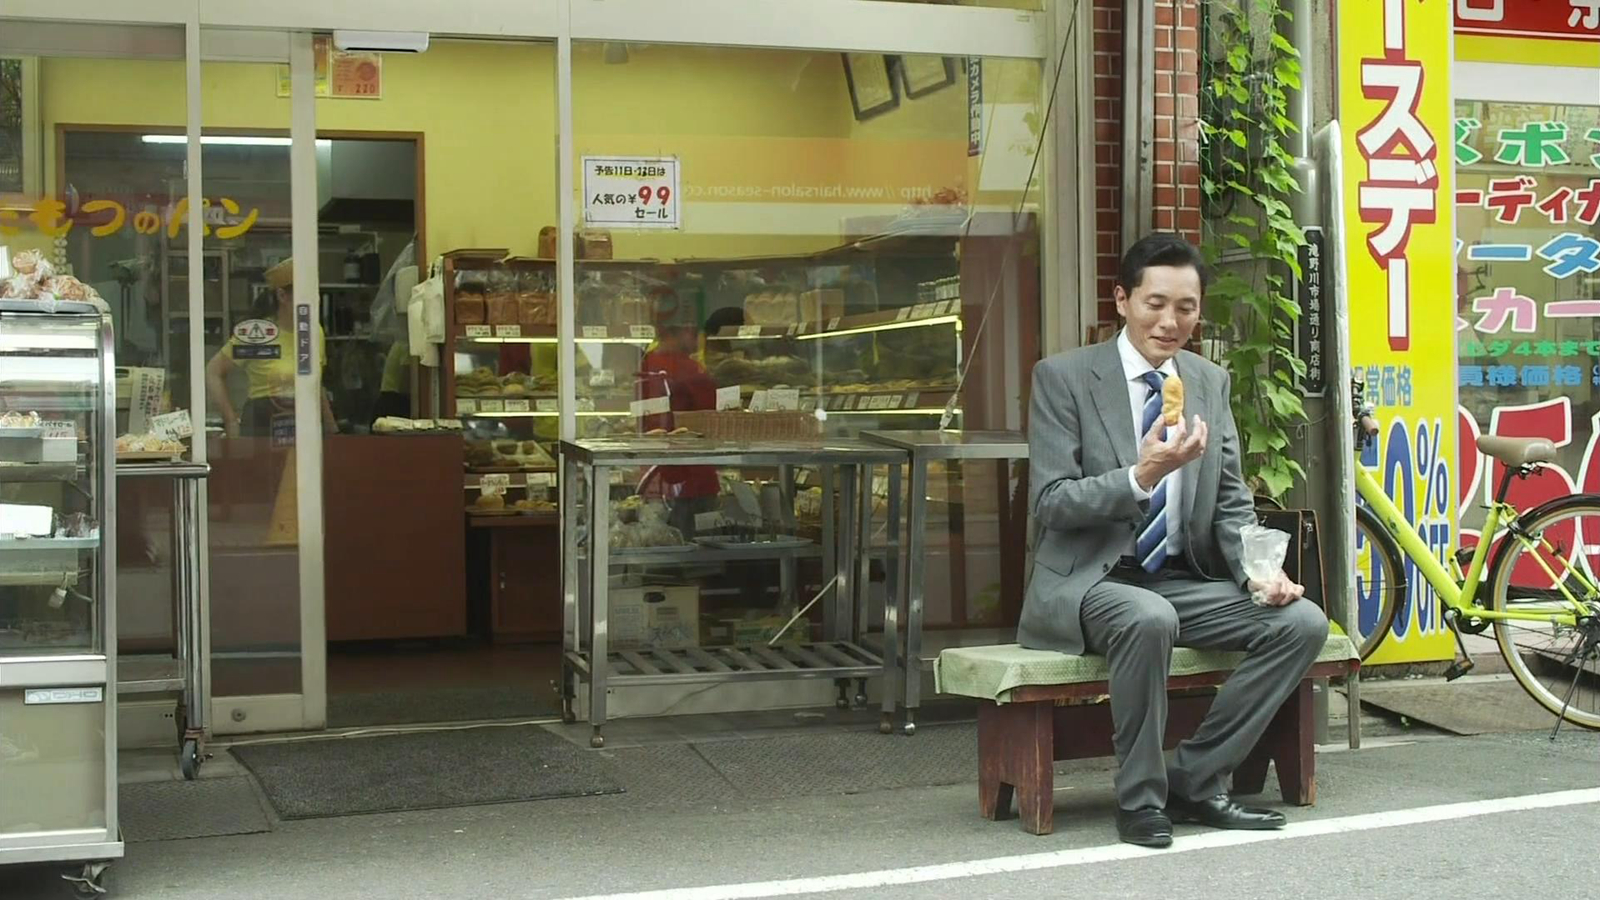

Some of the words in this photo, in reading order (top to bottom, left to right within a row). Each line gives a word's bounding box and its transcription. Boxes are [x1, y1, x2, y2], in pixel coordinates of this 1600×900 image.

[635, 206, 669, 219] セール
[1351, 365, 1412, 407] 常価格
